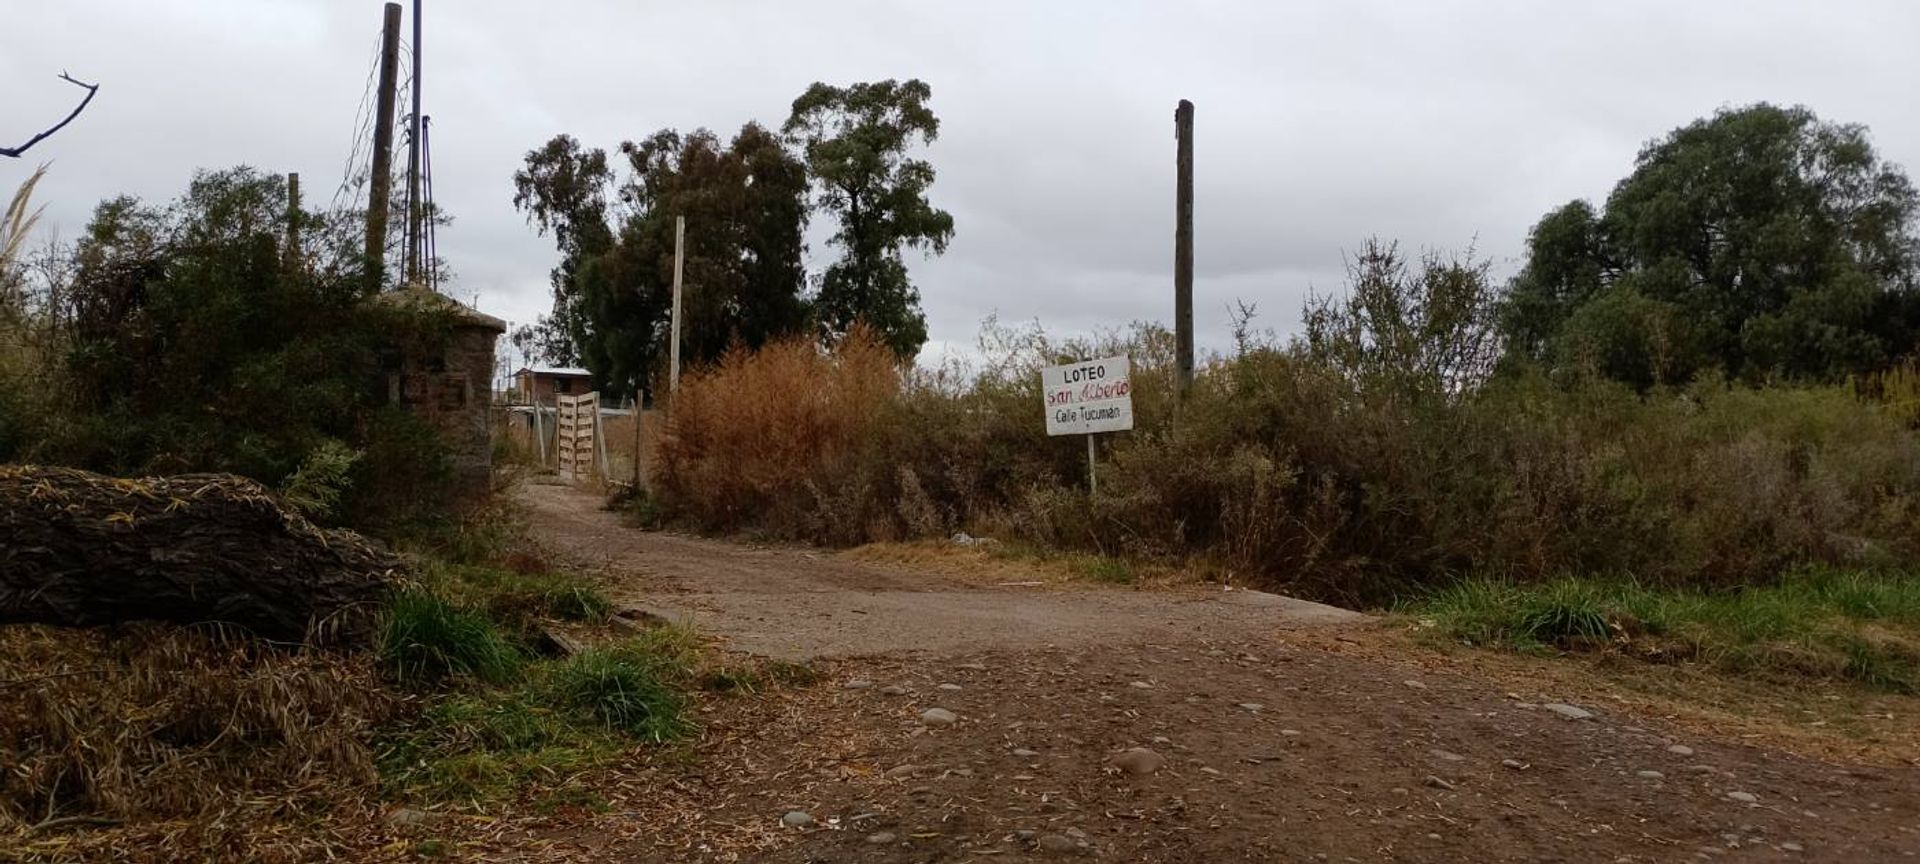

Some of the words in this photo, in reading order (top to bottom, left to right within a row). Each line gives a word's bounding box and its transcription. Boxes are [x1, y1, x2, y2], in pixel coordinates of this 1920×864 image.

[1064, 365, 1105, 383] LOTEO
[1080, 381, 1129, 401] Alberto
[1056, 409, 1077, 423] Calle
